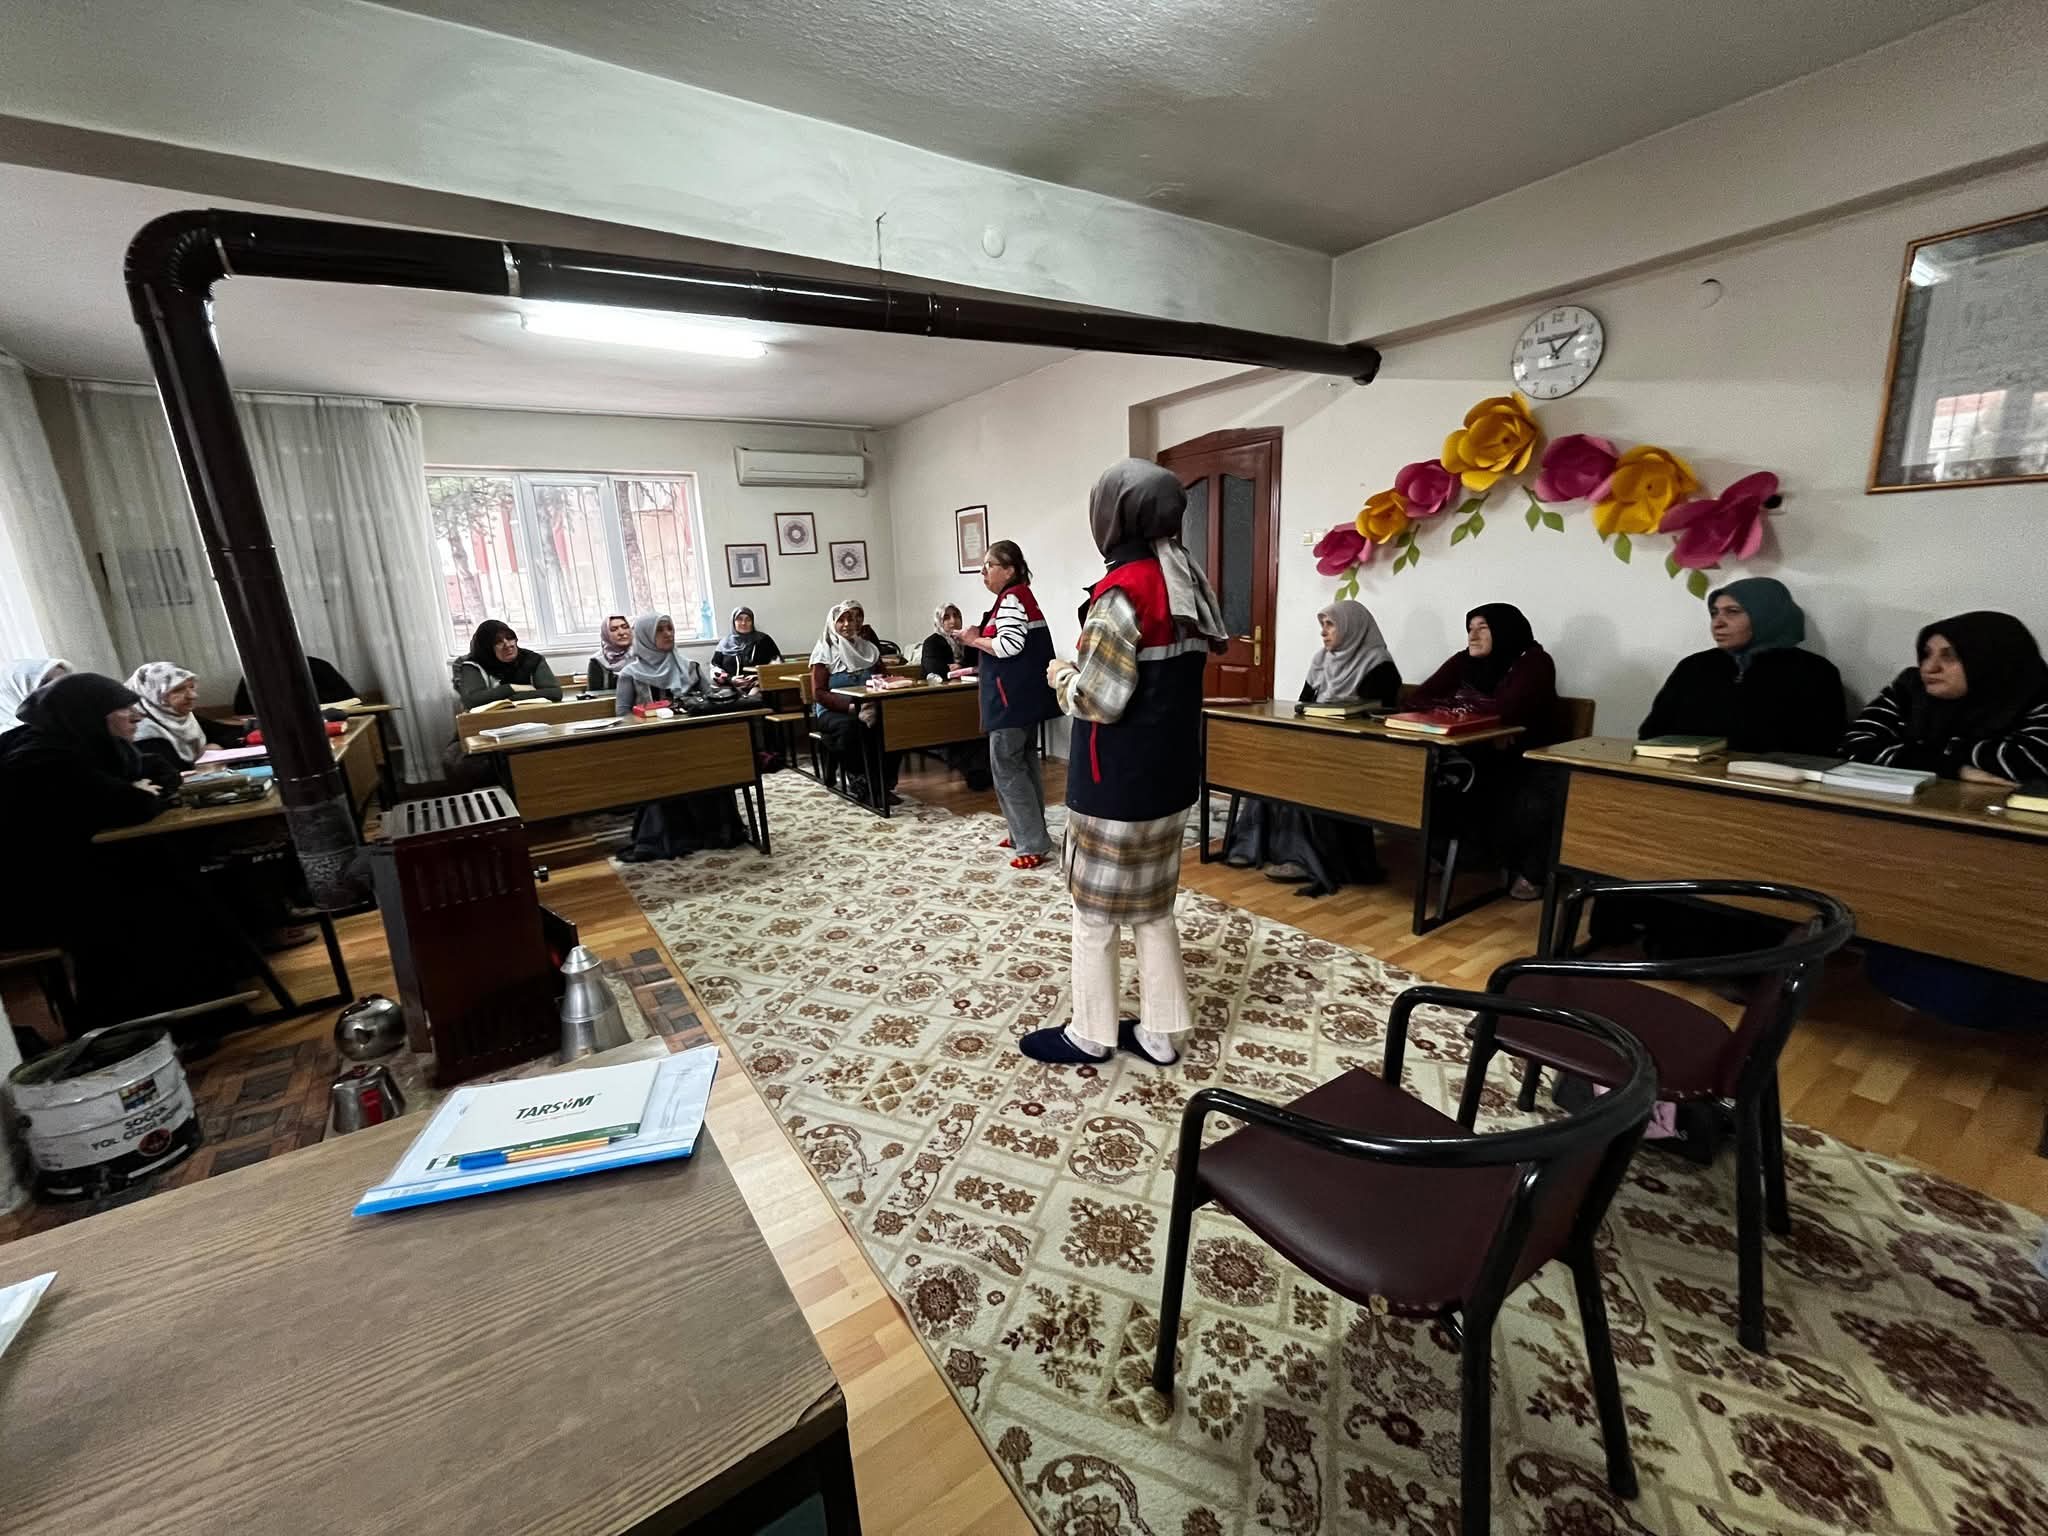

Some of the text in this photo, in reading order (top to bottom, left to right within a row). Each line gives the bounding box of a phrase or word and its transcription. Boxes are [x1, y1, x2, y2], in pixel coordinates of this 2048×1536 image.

[1552, 311, 1565, 324] 12
[1535, 321, 1545, 334] 11
[1520, 338, 1533, 350] 10
[1550, 383, 1558, 395] 6
[91, 1138, 120, 1151] YOL
